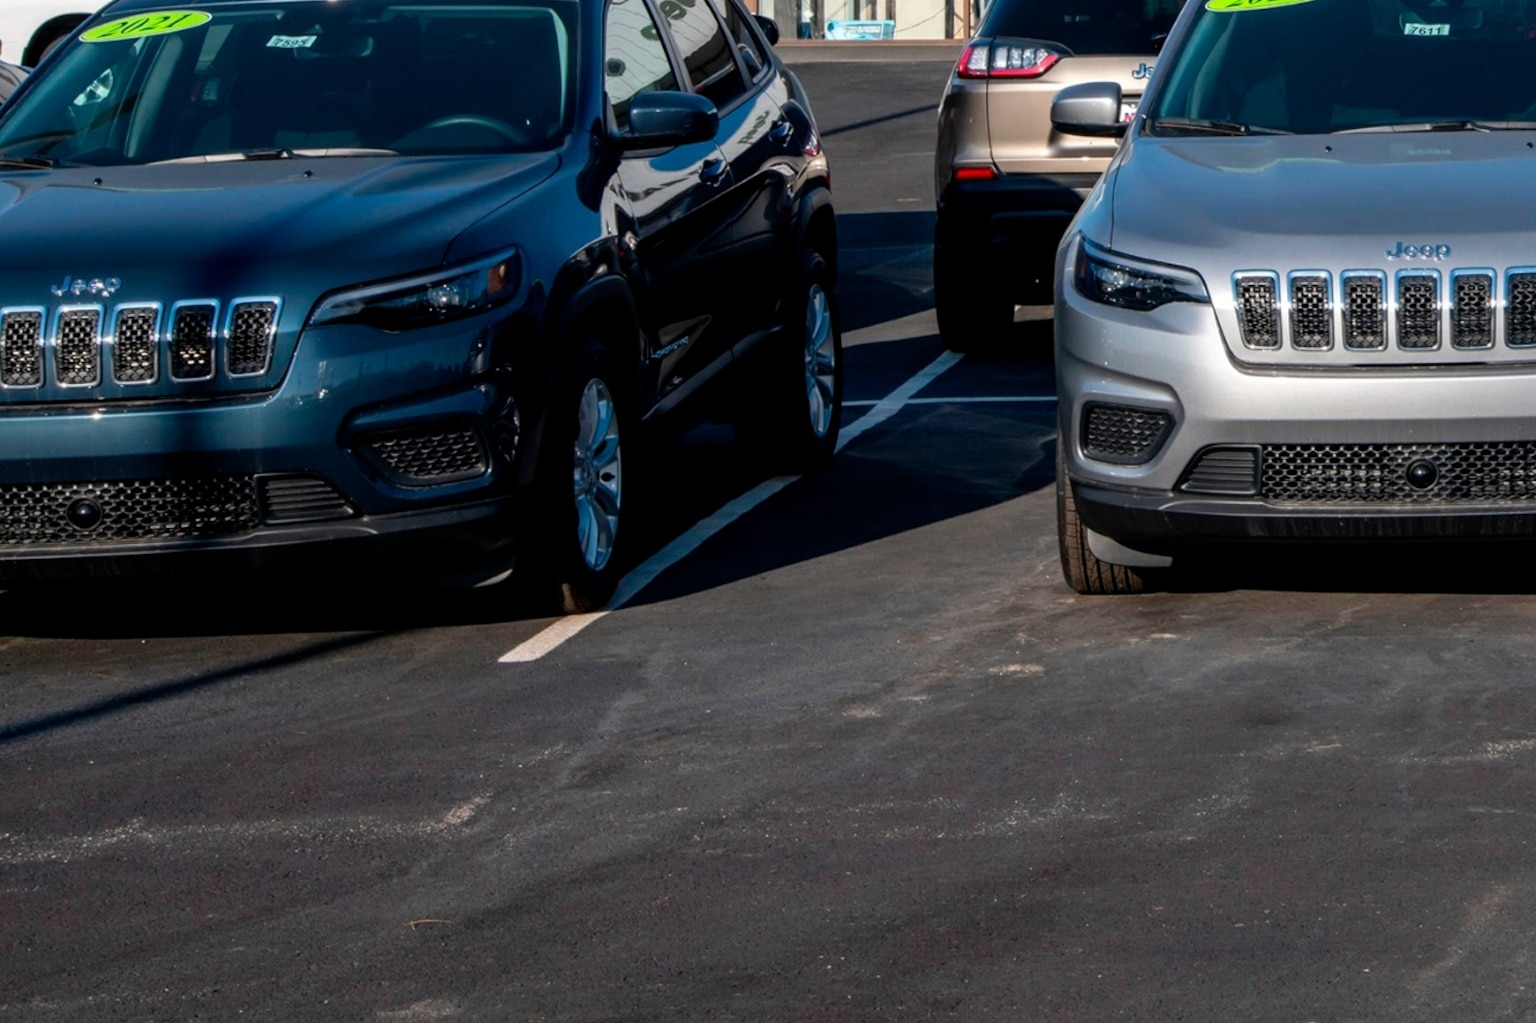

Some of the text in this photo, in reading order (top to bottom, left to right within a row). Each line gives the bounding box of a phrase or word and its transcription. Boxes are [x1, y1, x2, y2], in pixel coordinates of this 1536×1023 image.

[97, 13, 193, 39] 2021
[1410, 26, 1442, 36] 7611
[274, 37, 306, 47] 7595
[1385, 242, 1451, 261] Jeep
[51, 276, 122, 297] Jeep
